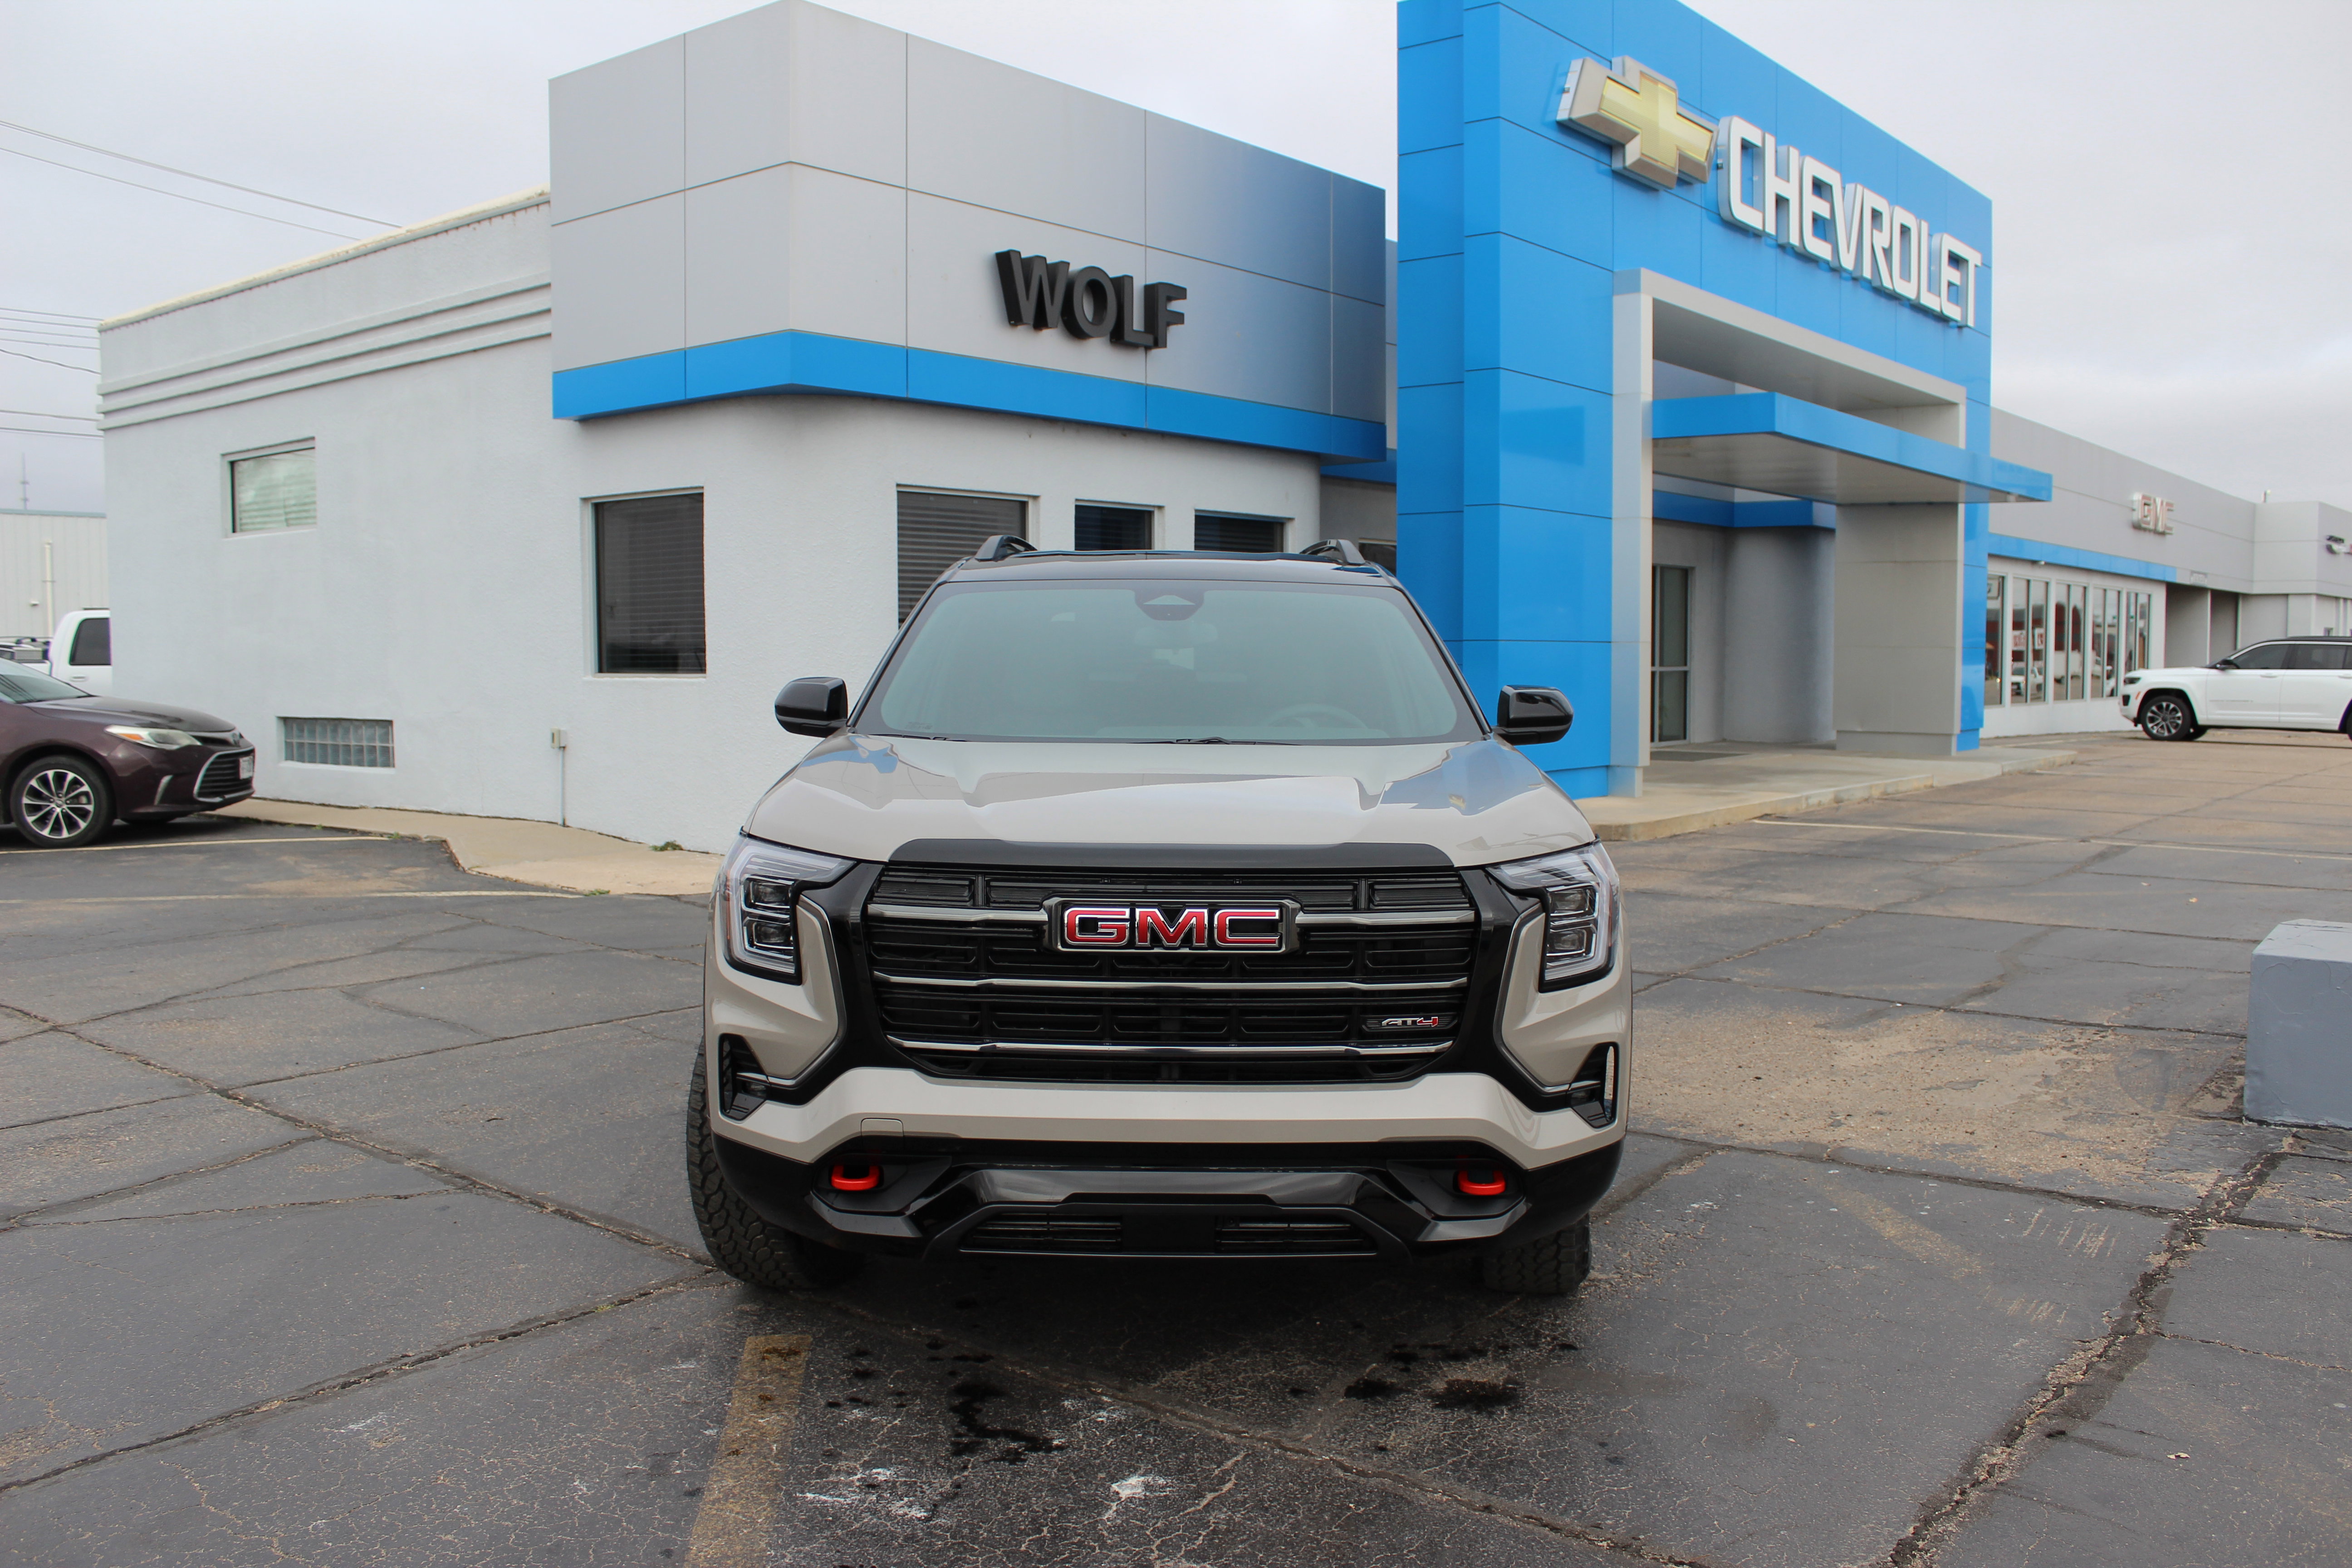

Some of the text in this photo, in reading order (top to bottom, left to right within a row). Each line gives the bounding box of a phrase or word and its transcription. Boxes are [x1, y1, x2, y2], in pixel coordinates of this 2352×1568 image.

[1717, 115, 1981, 327] CHEVROLET
[996, 250, 1187, 348] WOLF
[1064, 907, 1280, 947] GMC
[1382, 1017, 1438, 1027] AT4
